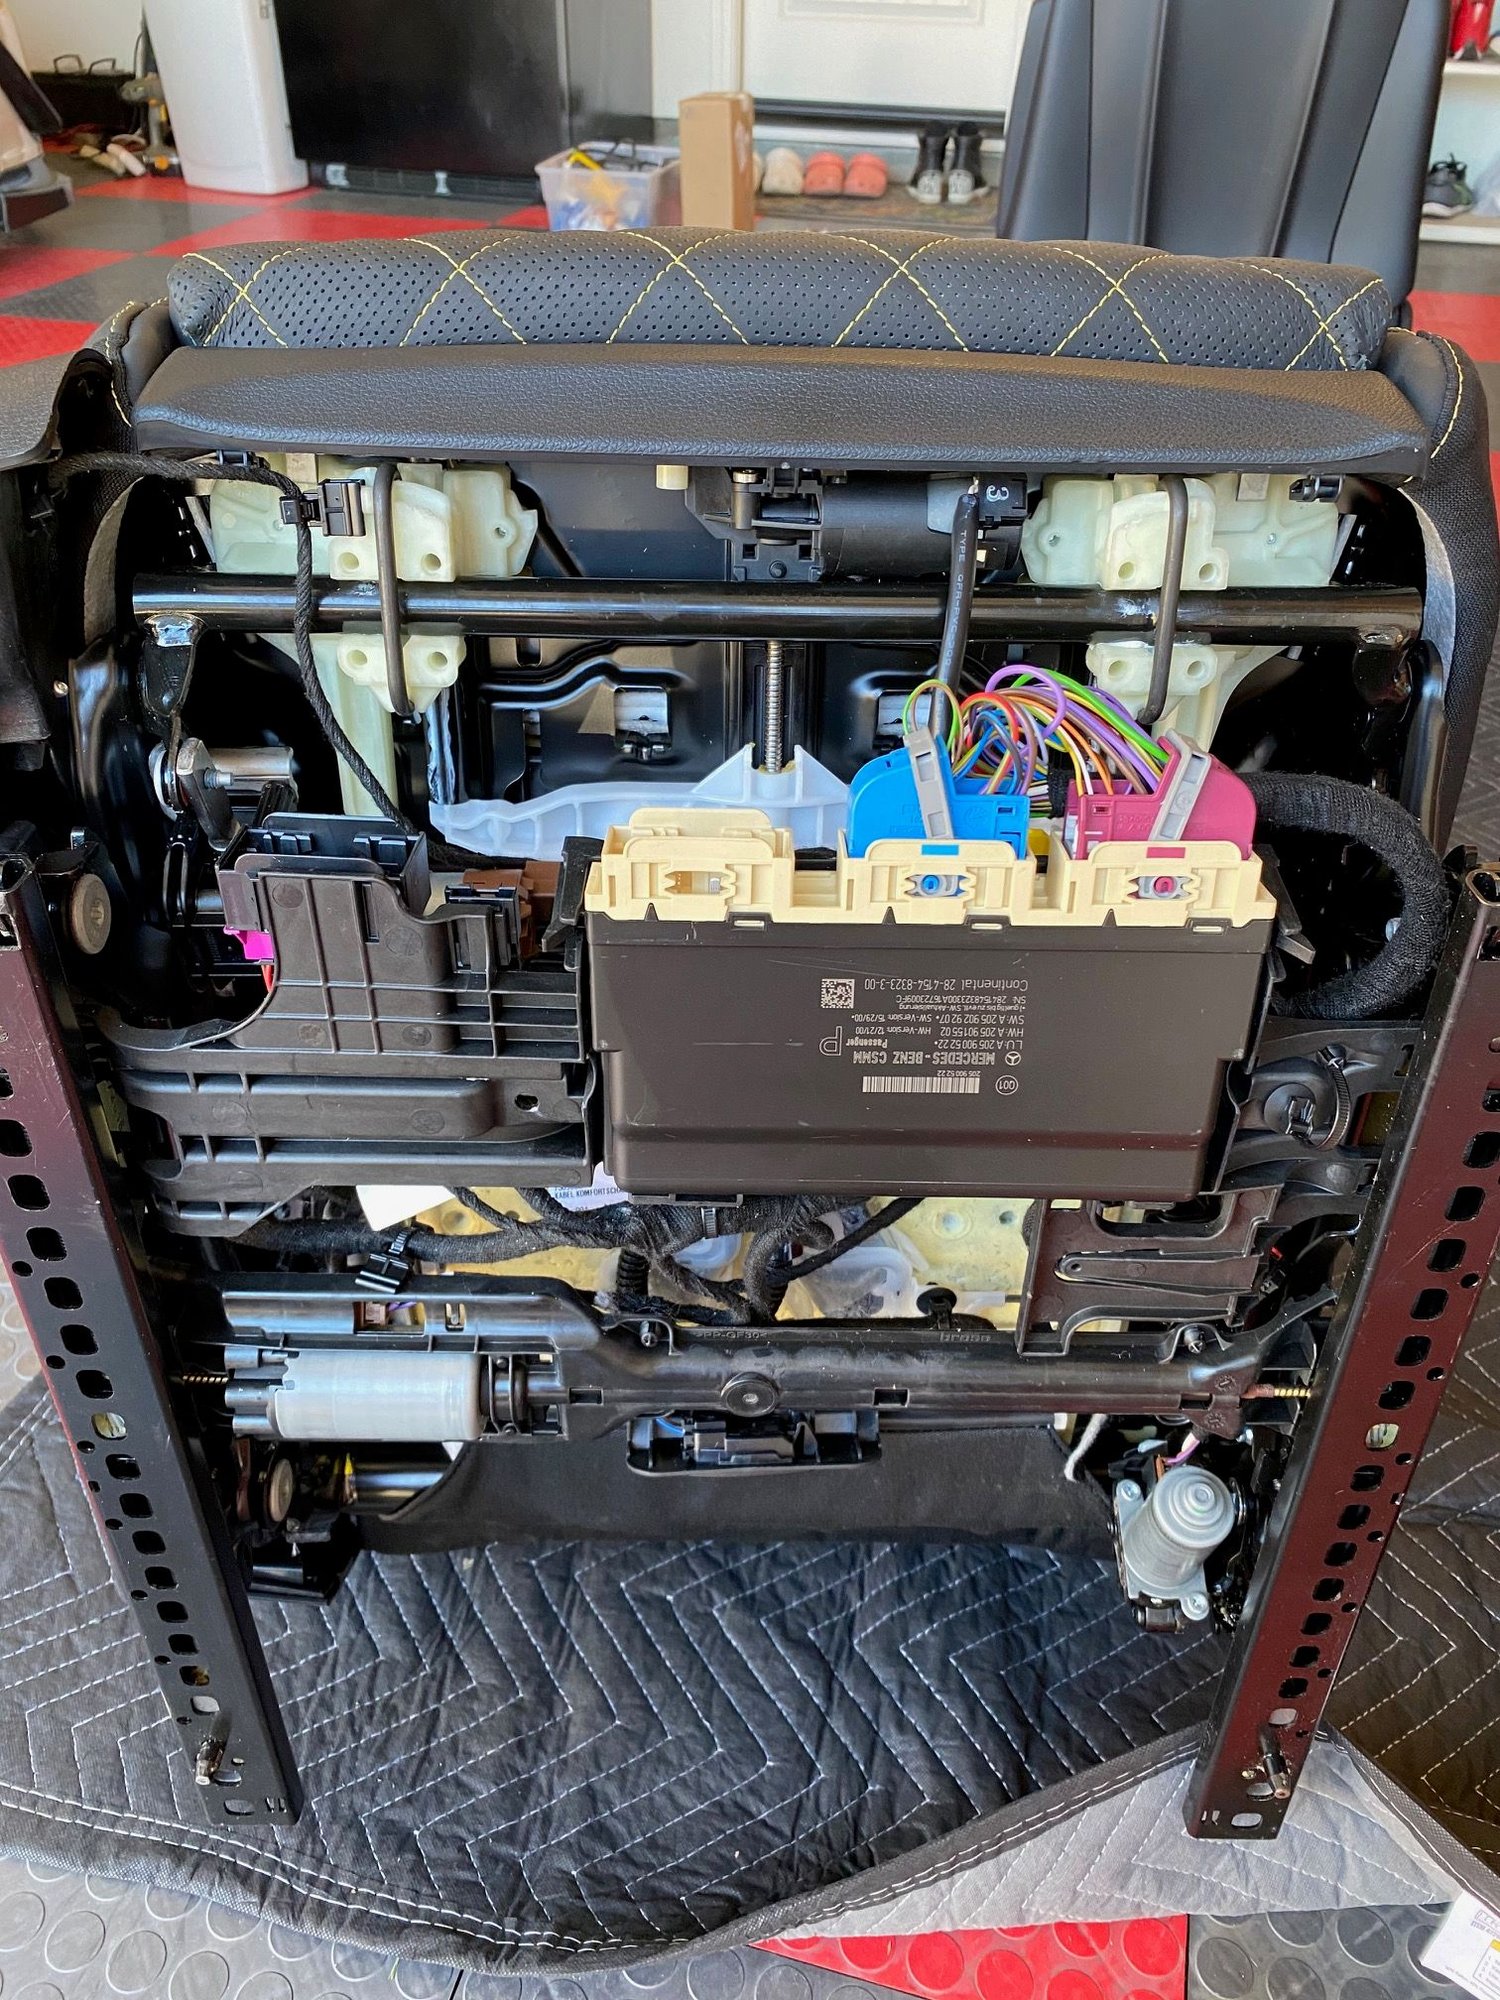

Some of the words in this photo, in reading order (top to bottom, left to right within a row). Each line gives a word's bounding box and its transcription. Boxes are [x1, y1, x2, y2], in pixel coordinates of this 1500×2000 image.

[986, 485, 1009, 502] 3
[958, 529, 967, 563] TYPE
[864, 978, 956, 991] 28-4154-8323-3-00
[961, 979, 1029, 991] Continental
[951, 1014, 962, 1023] 92
[964, 1014, 980, 1024] 902
[981, 1014, 997, 1024] 205
[856, 1026, 885, 1035] 12/21/00
[940, 1027, 951, 1036] 02
[980, 1027, 996, 1037] 205
[819, 1026, 842, 1056] P
[846, 1036, 888, 1048] Passenger
[950, 1040, 961, 1049] 52
[962, 1040, 978, 1049] 900
[979, 1040, 995, 1049] 205
[853, 1050, 887, 1064] CSMM
